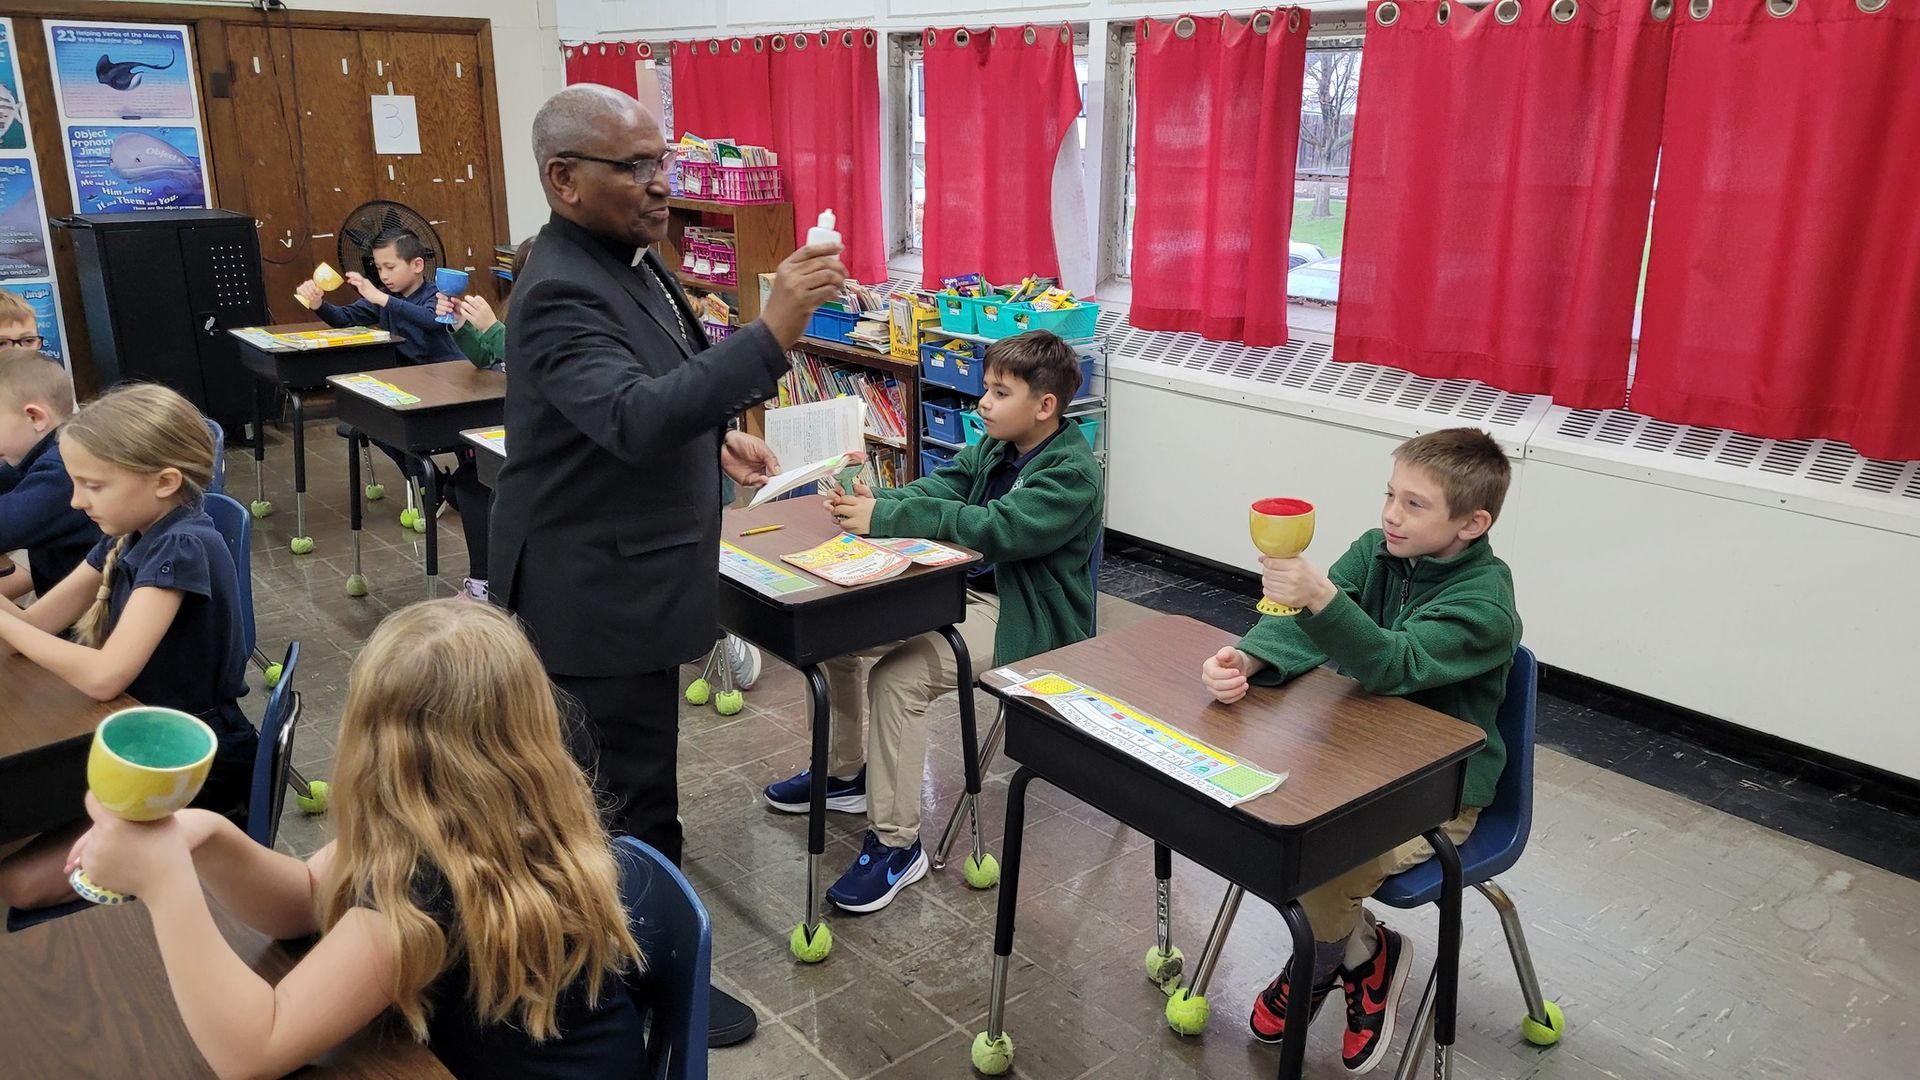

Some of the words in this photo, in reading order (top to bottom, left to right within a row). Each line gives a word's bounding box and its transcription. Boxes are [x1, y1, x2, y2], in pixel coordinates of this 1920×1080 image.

[57, 29, 76, 41] 23
[383, 103, 404, 139] 3
[74, 129, 108, 139] Object
[71, 139, 113, 147] Pronoun
[80, 147, 110, 156] Jingle
[80, 179, 94, 187] Me
[102, 187, 122, 195] Him
[134, 186, 152, 195] Her,
[97, 202, 106, 211] It
[117, 196, 145, 206] Them
[158, 195, 179, 205] You.
[1157, 749, 1190, 767] Nick
